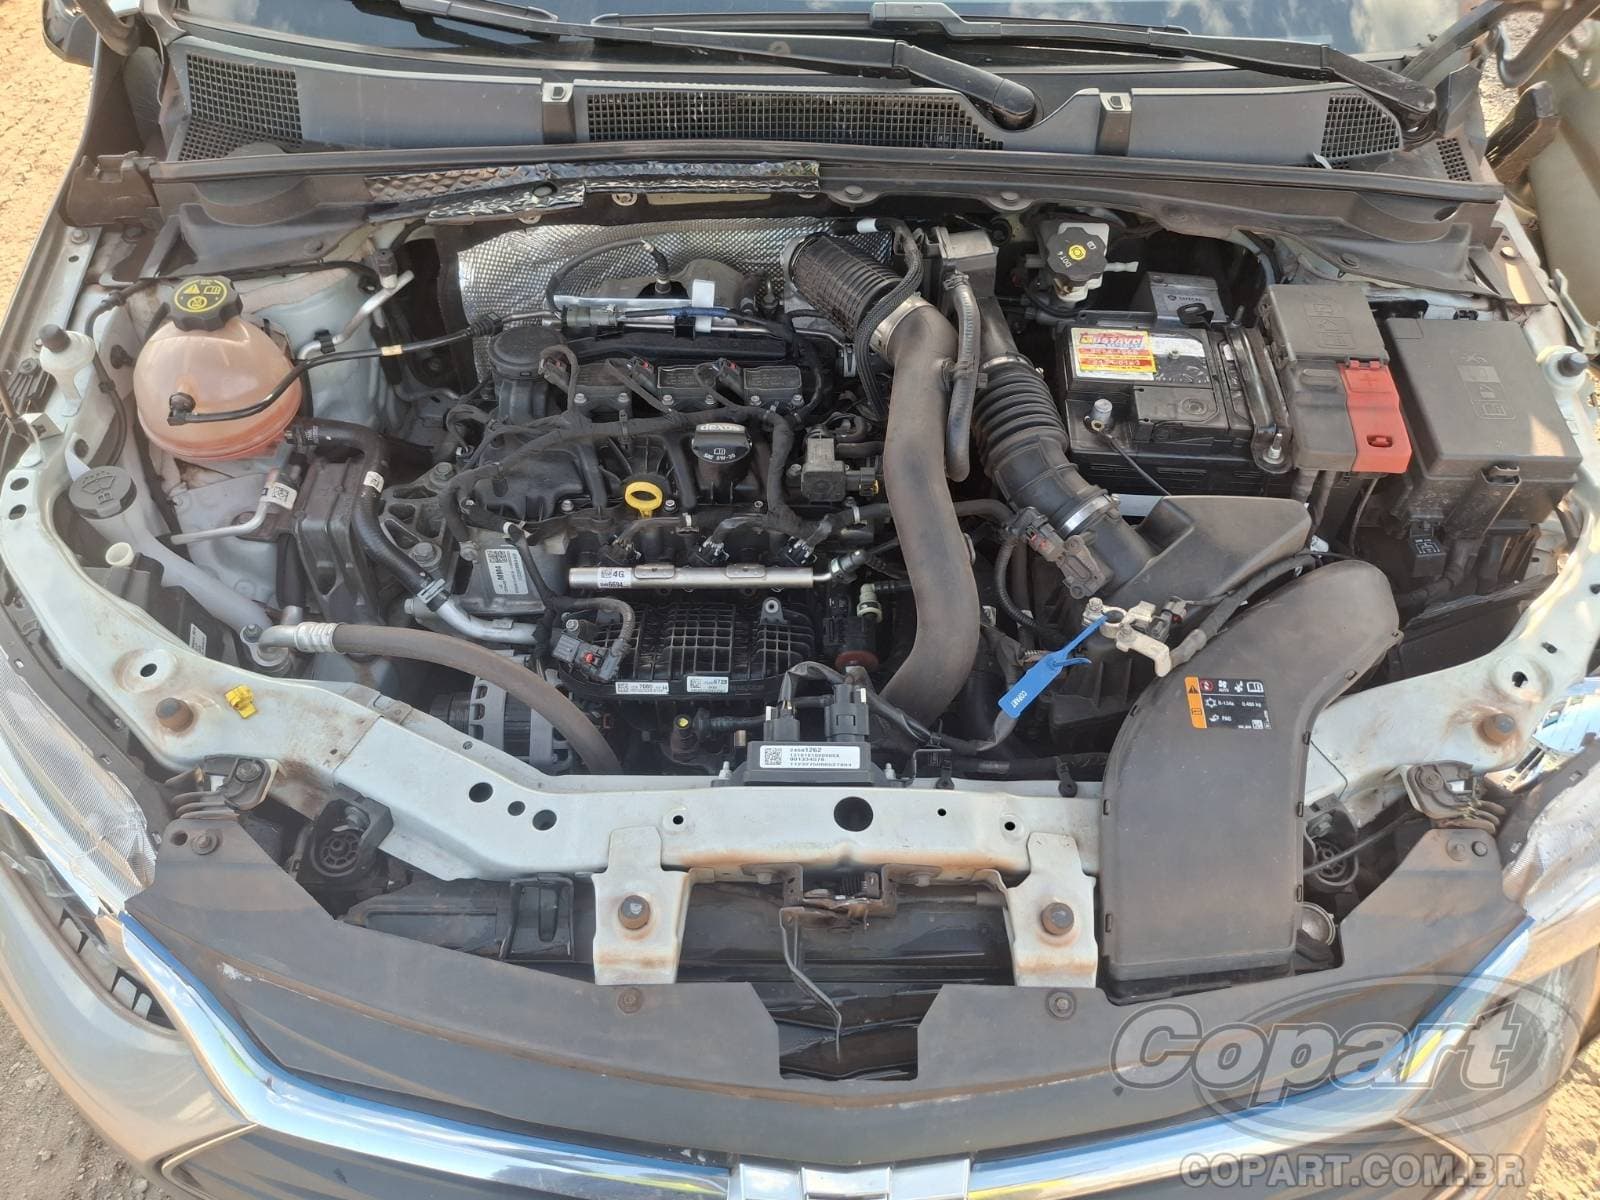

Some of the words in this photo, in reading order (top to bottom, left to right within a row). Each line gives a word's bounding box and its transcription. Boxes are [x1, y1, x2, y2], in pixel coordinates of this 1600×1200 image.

[1060, 256, 1072, 268] DOT
[700, 423, 741, 431] dexos
[612, 570, 625, 578] 4G
[1011, 690, 1028, 708] COPART
